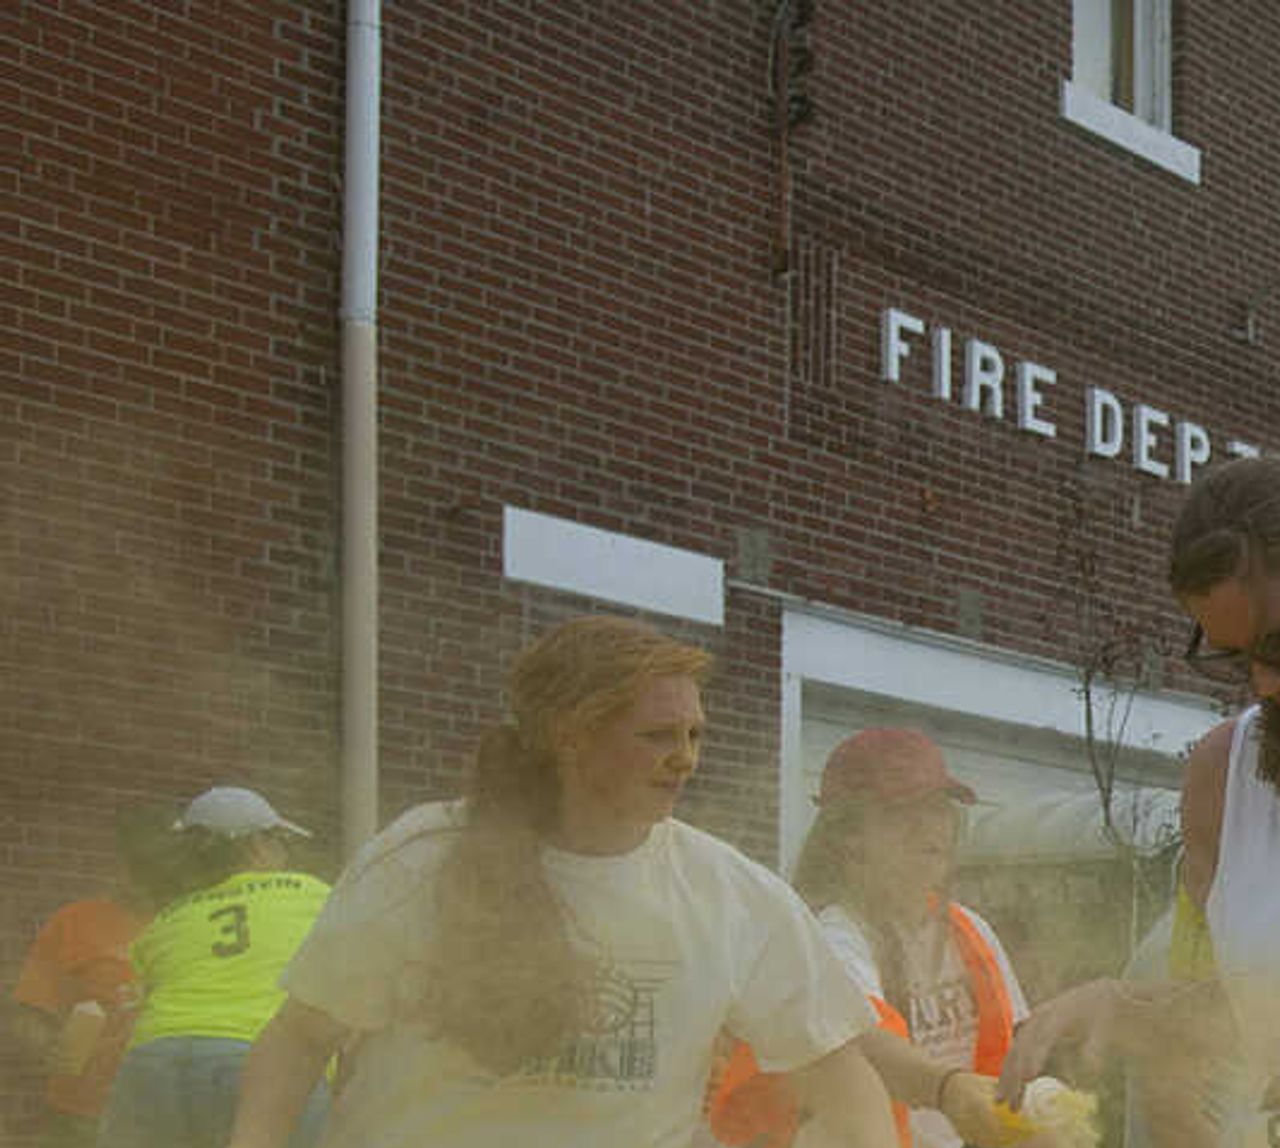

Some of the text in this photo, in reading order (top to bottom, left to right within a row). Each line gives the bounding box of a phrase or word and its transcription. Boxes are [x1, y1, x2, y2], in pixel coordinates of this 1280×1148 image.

[881, 307, 1262, 485] FIRE DEP
[208, 904, 250, 957] 3
